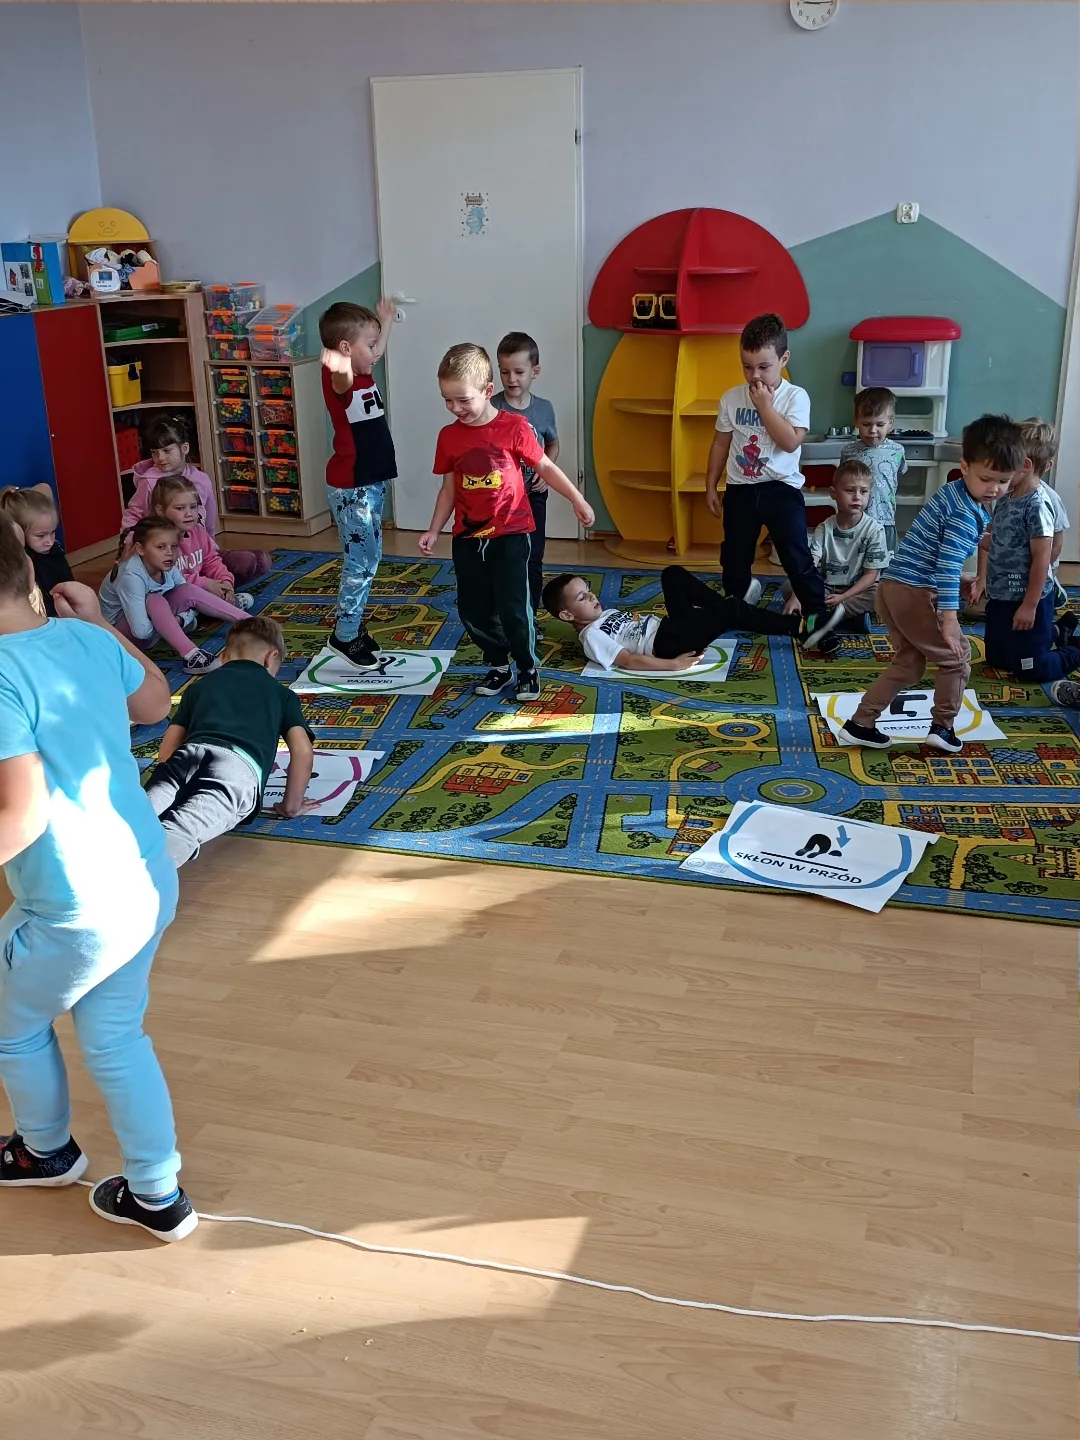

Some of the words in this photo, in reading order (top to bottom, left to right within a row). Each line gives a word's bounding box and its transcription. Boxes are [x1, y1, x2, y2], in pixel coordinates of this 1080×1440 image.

[734, 851, 785, 868] SKŁON
[788, 863, 806, 872] W
[808, 867, 863, 885] PRZÓD
